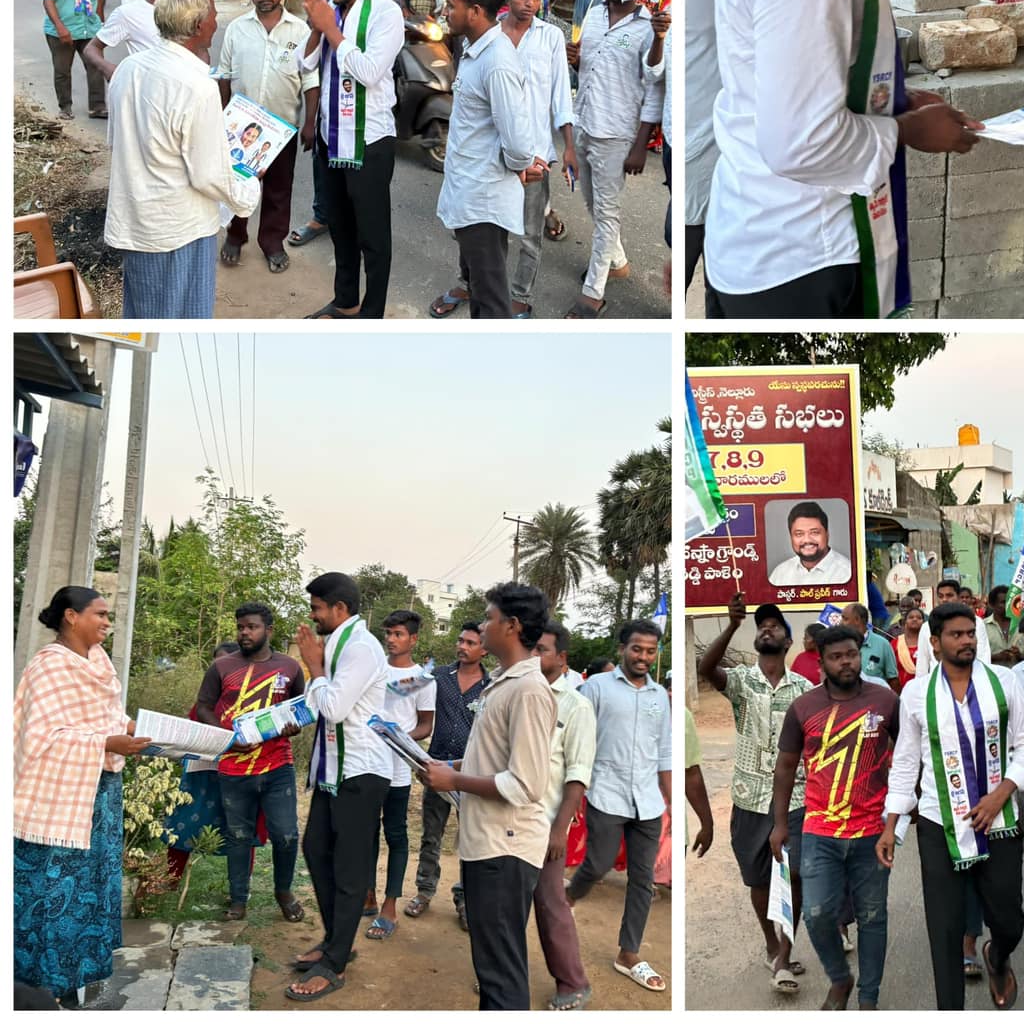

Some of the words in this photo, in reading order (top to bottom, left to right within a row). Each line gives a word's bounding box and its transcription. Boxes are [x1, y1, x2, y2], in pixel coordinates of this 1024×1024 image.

[701, 404, 767, 443] స్వస్థత
[775, 404, 845, 433] సభలు
[708, 450, 764, 470] 7,8,9
